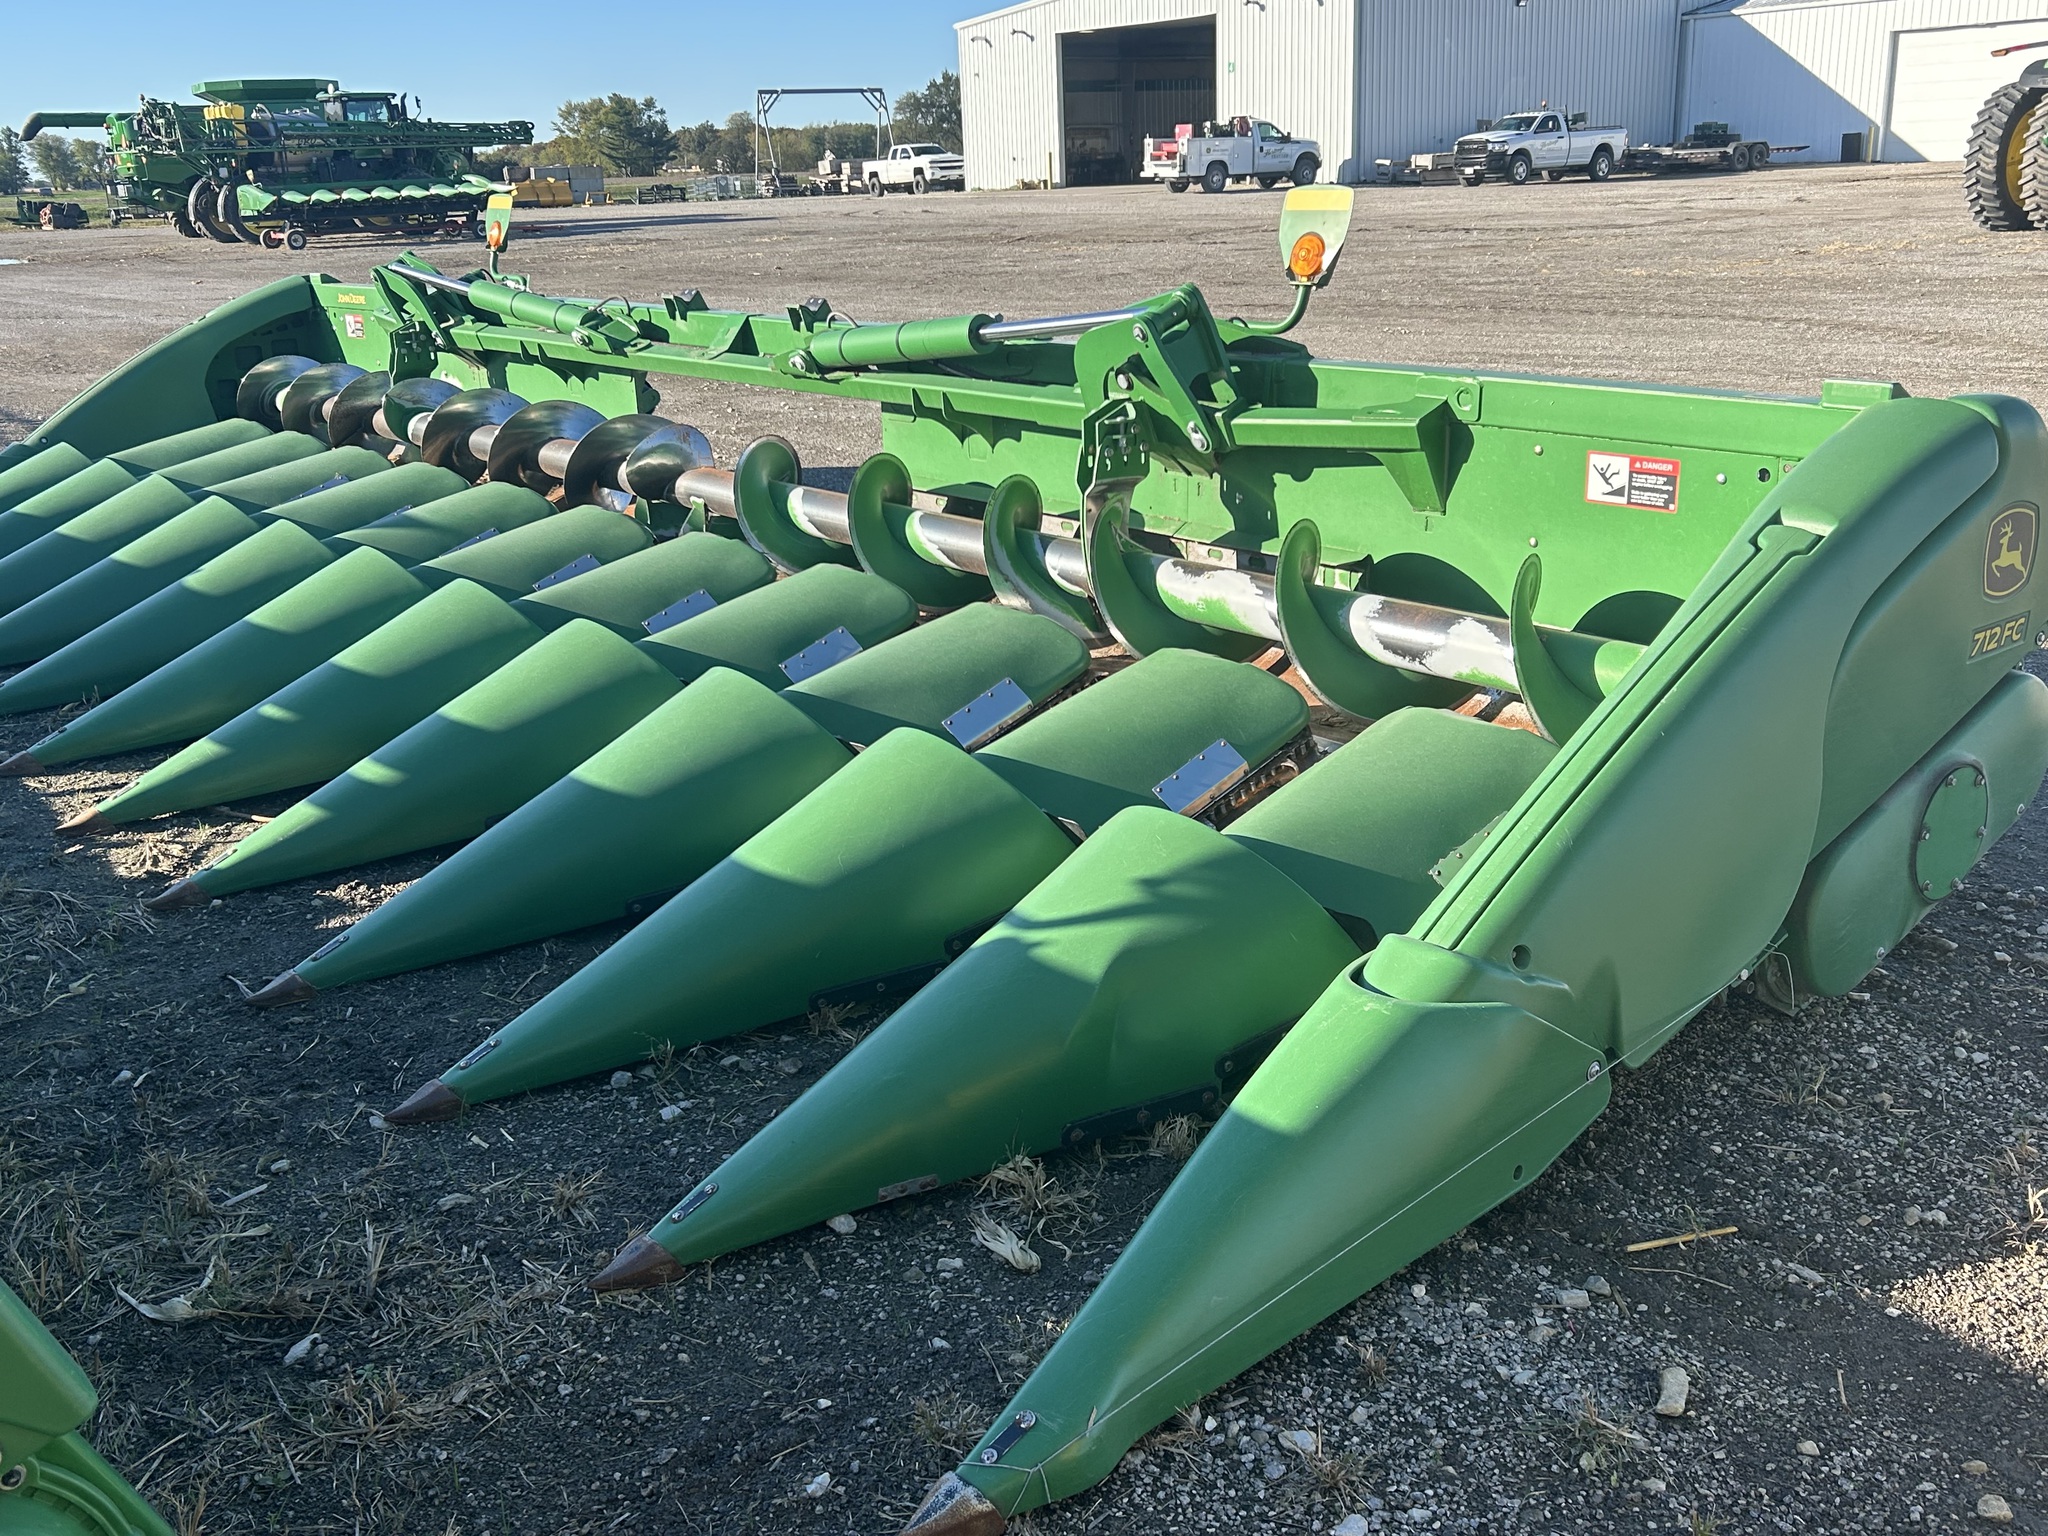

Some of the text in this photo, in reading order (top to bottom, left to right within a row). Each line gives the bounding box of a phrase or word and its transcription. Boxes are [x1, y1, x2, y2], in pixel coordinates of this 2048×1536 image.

[1642, 461, 1673, 472] DANGER
[1970, 616, 2026, 657] 712 FC
